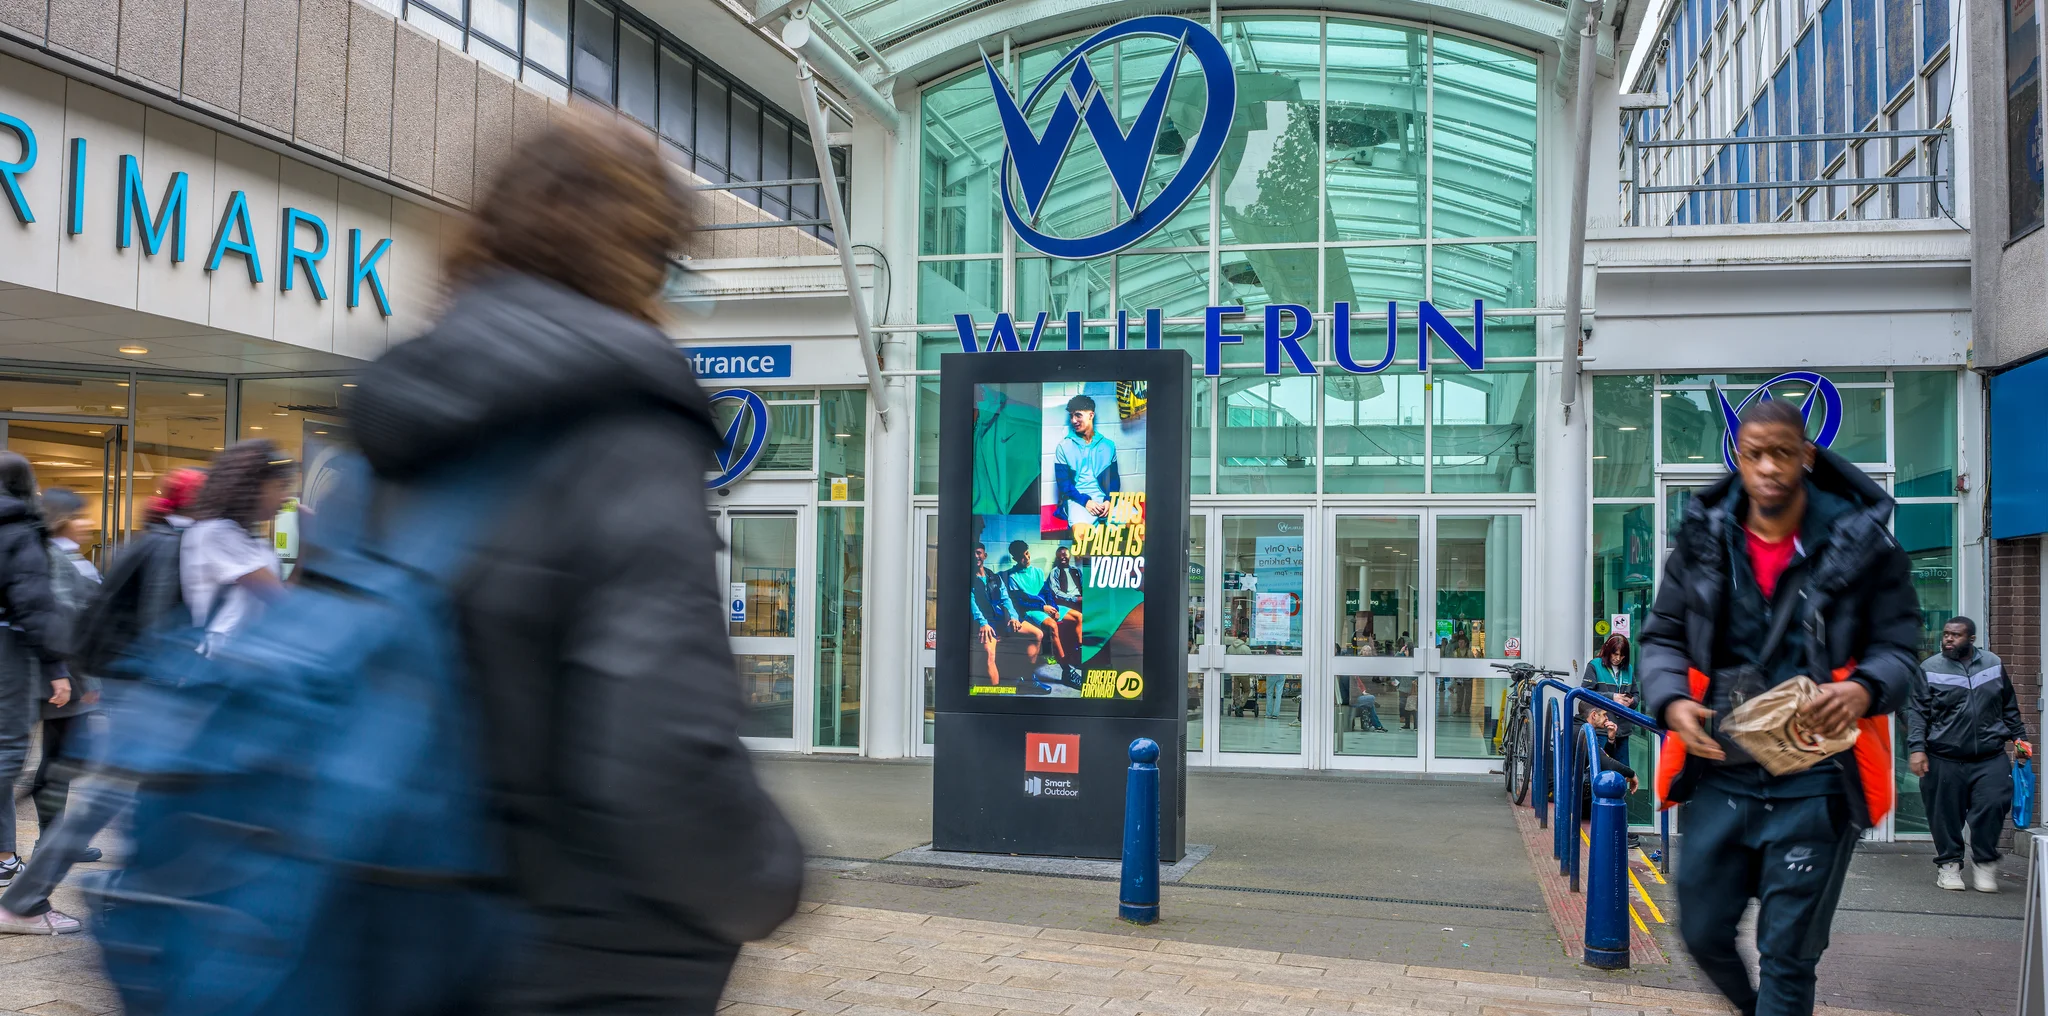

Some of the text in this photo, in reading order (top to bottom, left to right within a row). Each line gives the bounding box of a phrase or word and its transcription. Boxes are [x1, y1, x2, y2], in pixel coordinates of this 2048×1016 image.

[1107, 491, 1146, 524] THIS
[1070, 523, 1146, 556] SPACE IS
[1088, 556, 1145, 588] YOURS
[1081, 684, 1116, 698] FORWARD
[1086, 669, 1140, 691] FOREVER JD
[1038, 742, 1067, 764] M
[1044, 779, 1071, 787] Smart
[1044, 787, 1079, 796] Outdoor
